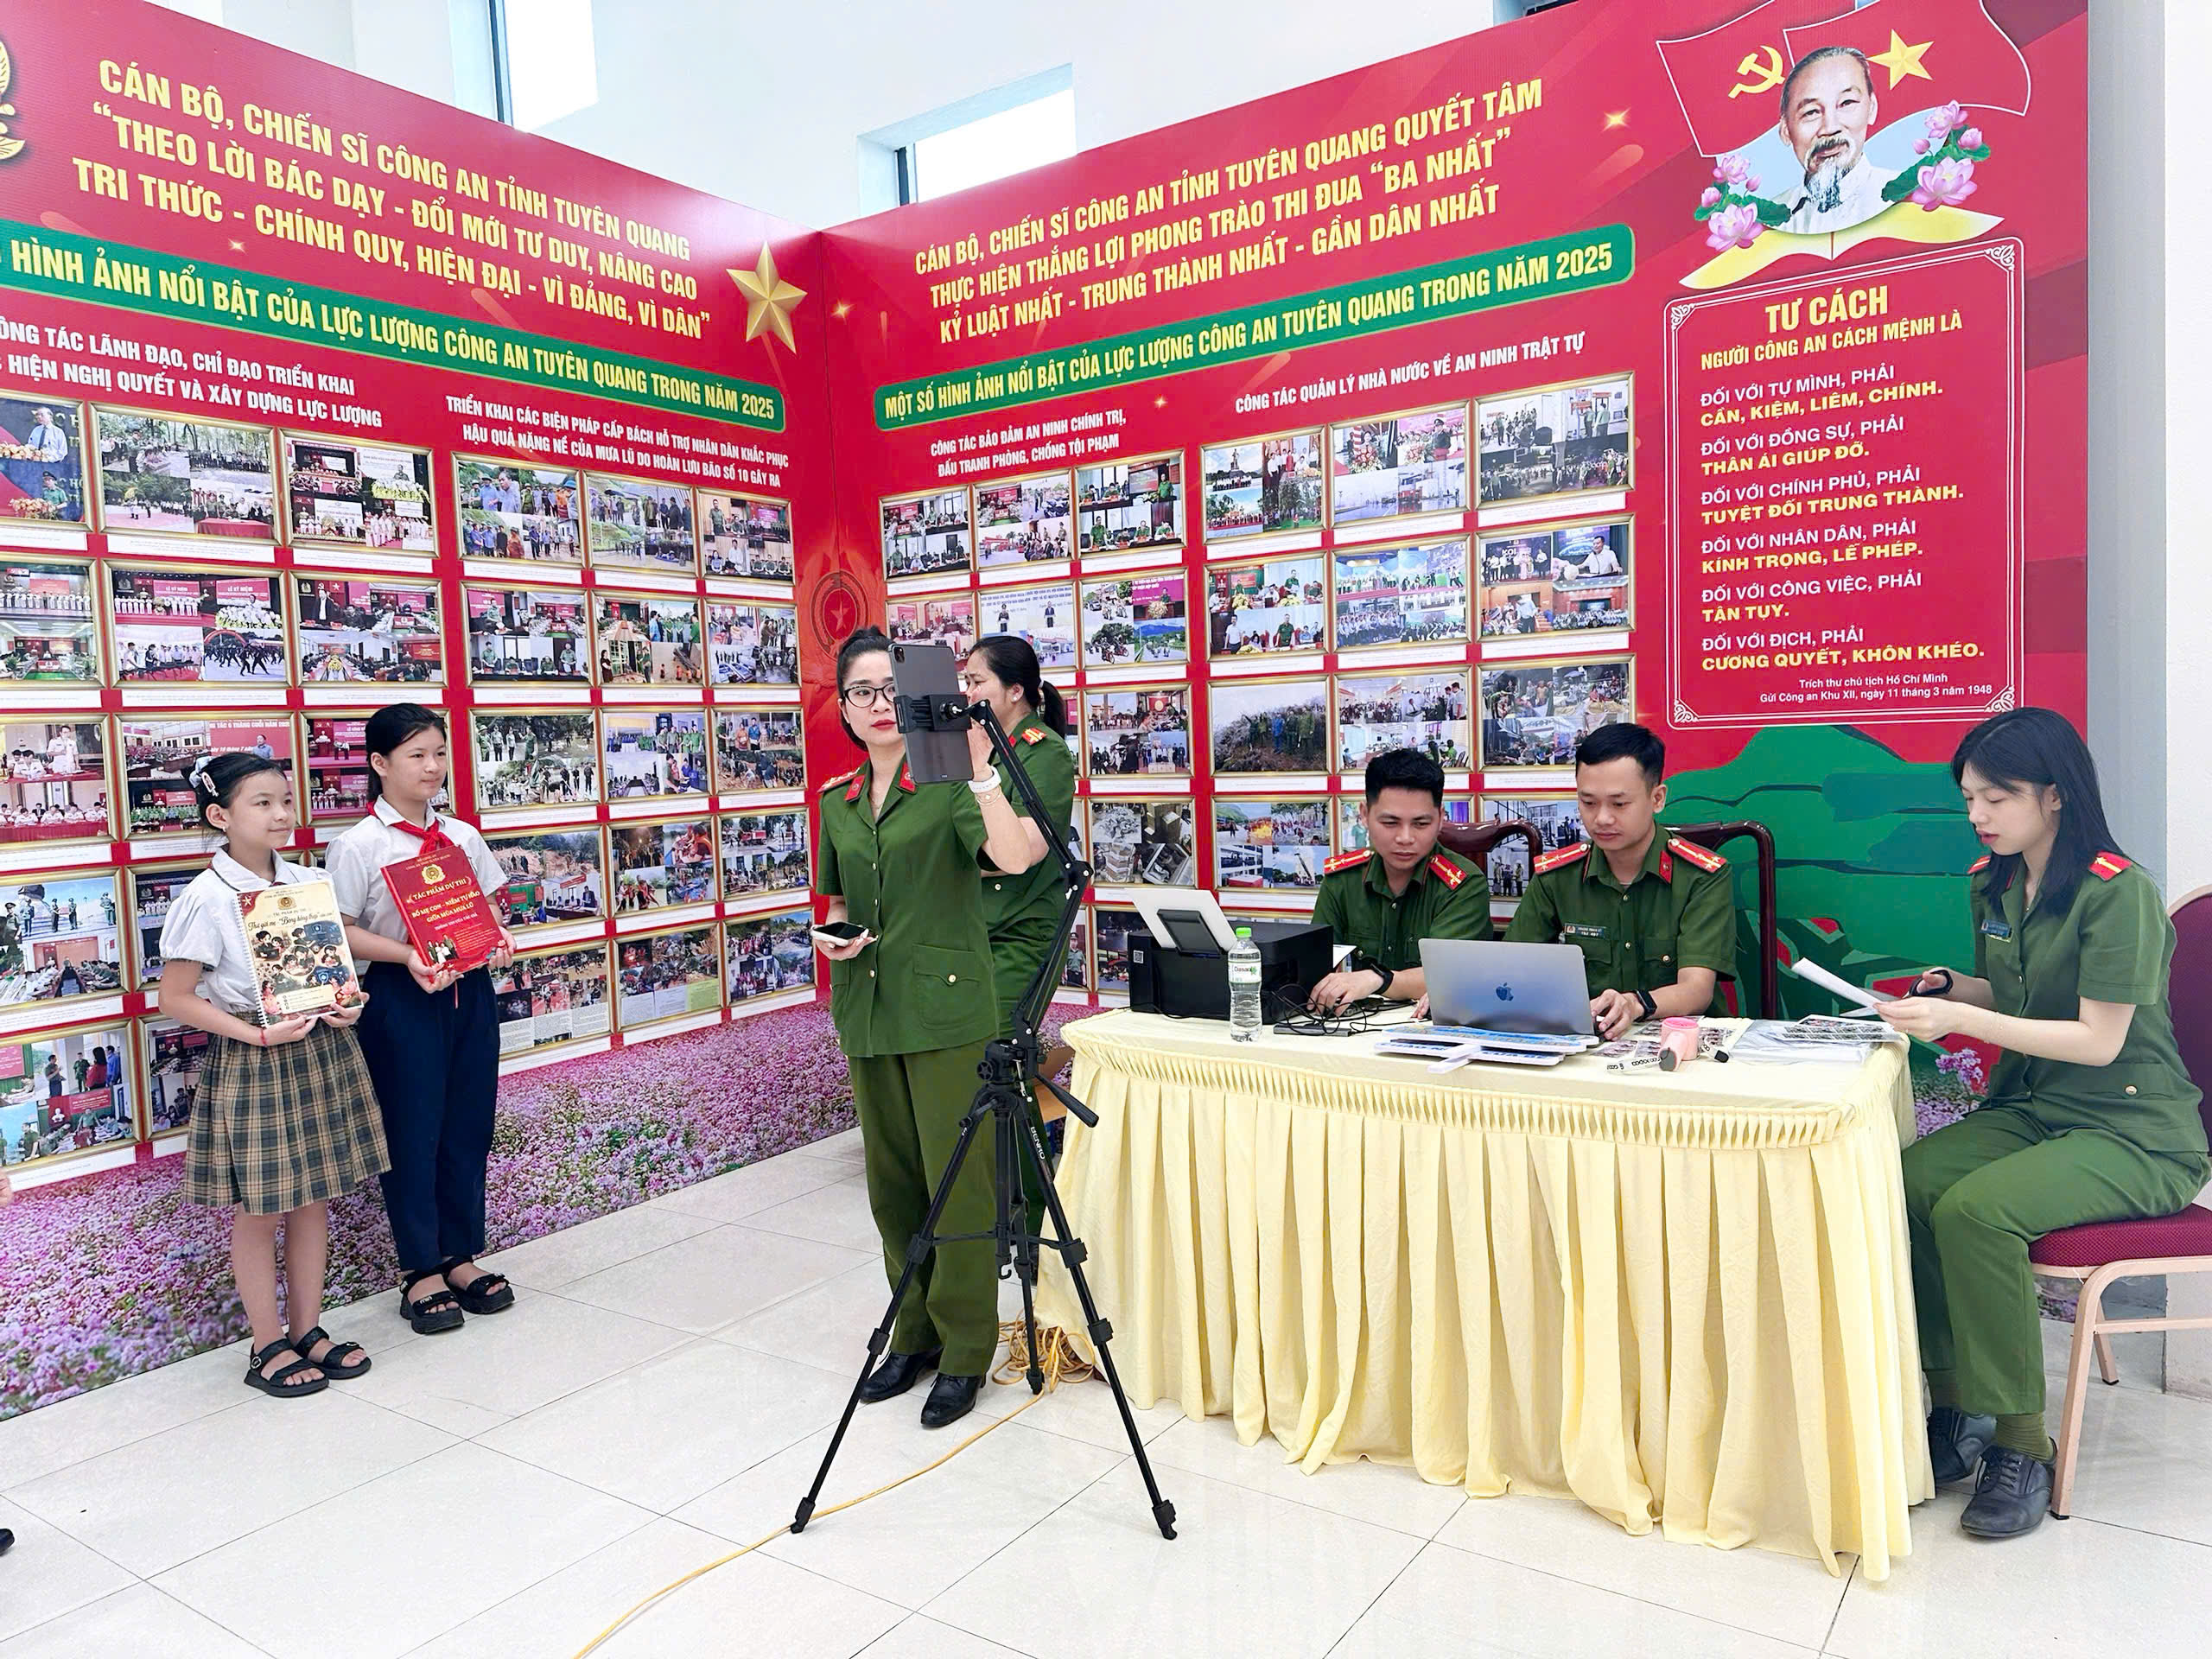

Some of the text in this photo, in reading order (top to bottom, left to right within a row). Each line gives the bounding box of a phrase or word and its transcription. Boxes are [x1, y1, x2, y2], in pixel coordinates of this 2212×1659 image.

[931, 276, 975, 308] THỰC
[979, 263, 1021, 296] HIỆN
[1027, 245, 1089, 283] THẮNG
[1095, 235, 1125, 269] LỢI
[1131, 217, 1202, 257] PHONG
[1209, 200, 1265, 238] TRÀO
[1272, 188, 1308, 221] THI
[1315, 175, 1363, 211] ĐUA
[10, 237, 774, 420] HÌNH ẢNH NỔI BẬT CỦA LỰC LƯỢNG CÔNG AN TUYÊN QUANG TRONG NĂM 2025
[1765, 286, 1888, 334] TƯ CÁCH
[0, 315, 354, 396] ÔNG TÁC LÃNH ĐẠO, CHỈ ĐẠO TRIỂN KHAI
[1701, 309, 1962, 370] NGƯỜI CÔNG AN CÁCH MỆNH LÀ
[1236, 331, 1586, 413] CÔNG TÁC QUẢN LÝ NHÀ NƯỚC VỀ AN NINH TRẬT TỰ
[1700, 362, 1894, 407] ĐỐI VỚI TỰ MÌNH, PHẢI
[1700, 381, 1943, 426] CẦN, KIỆM, LIÊM, CHÍNH.
[446, 394, 482, 416] TRIỂN
[485, 402, 513, 422] KHAI
[517, 406, 540, 425] CÁC
[542, 411, 569, 432] BIỆN
[571, 416, 601, 435] PHÁP
[603, 420, 624, 439] CẤP
[626, 425, 654, 444] BÁCH
[671, 435, 690, 453] TRỢ
[692, 438, 718, 455] NHÂN
[720, 442, 740, 459] DÂN
[766, 451, 789, 469] PHỤC
[1700, 414, 1904, 456] ĐỐI VỚI ĐỒNG SỰ, PHẢI
[938, 433, 1119, 477] ĐẤU TRANH PHÒNG, CHỐNG TỘI PHẠM
[1701, 441, 1869, 475] THÂN ÁI GIÚP ĐỠ.
[1700, 464, 1920, 505] ĐỐI VỚI CHÍNH PHỦ, PHẢI
[1701, 485, 1963, 524] TUYỆT ĐỐI TRUNG THÀNH.
[1702, 556, 1749, 574] KÍNH
[1754, 550, 1827, 569] TRỌNG,
[1862, 540, 1923, 559] PHÉP.
[1702, 604, 1789, 624] TẬN TỤY.
[1701, 625, 1863, 651] ĐỐI VỚI ĐỊCH, PHẢI
[1702, 641, 1985, 671] CƯƠNG QUYẾT, KHÔN KHÉO.
[1778, 693, 1804, 703] Công
[1821, 691, 1840, 700] Khu
[1843, 690, 1858, 700] XII,
[1860, 689, 1885, 701] ngày
[1888, 689, 1897, 697] 11
[1902, 688, 1930, 698] tháng
[1933, 686, 1940, 696] 3
[1968, 684, 1993, 695] 1948
[1799, 678, 1823, 688] Trích
[1826, 678, 1842, 688] thư
[1844, 677, 1863, 686] chủ
[1865, 677, 1884, 688] tịch
[1903, 674, 1920, 684] Chí
[1923, 673, 1948, 683] Minh
